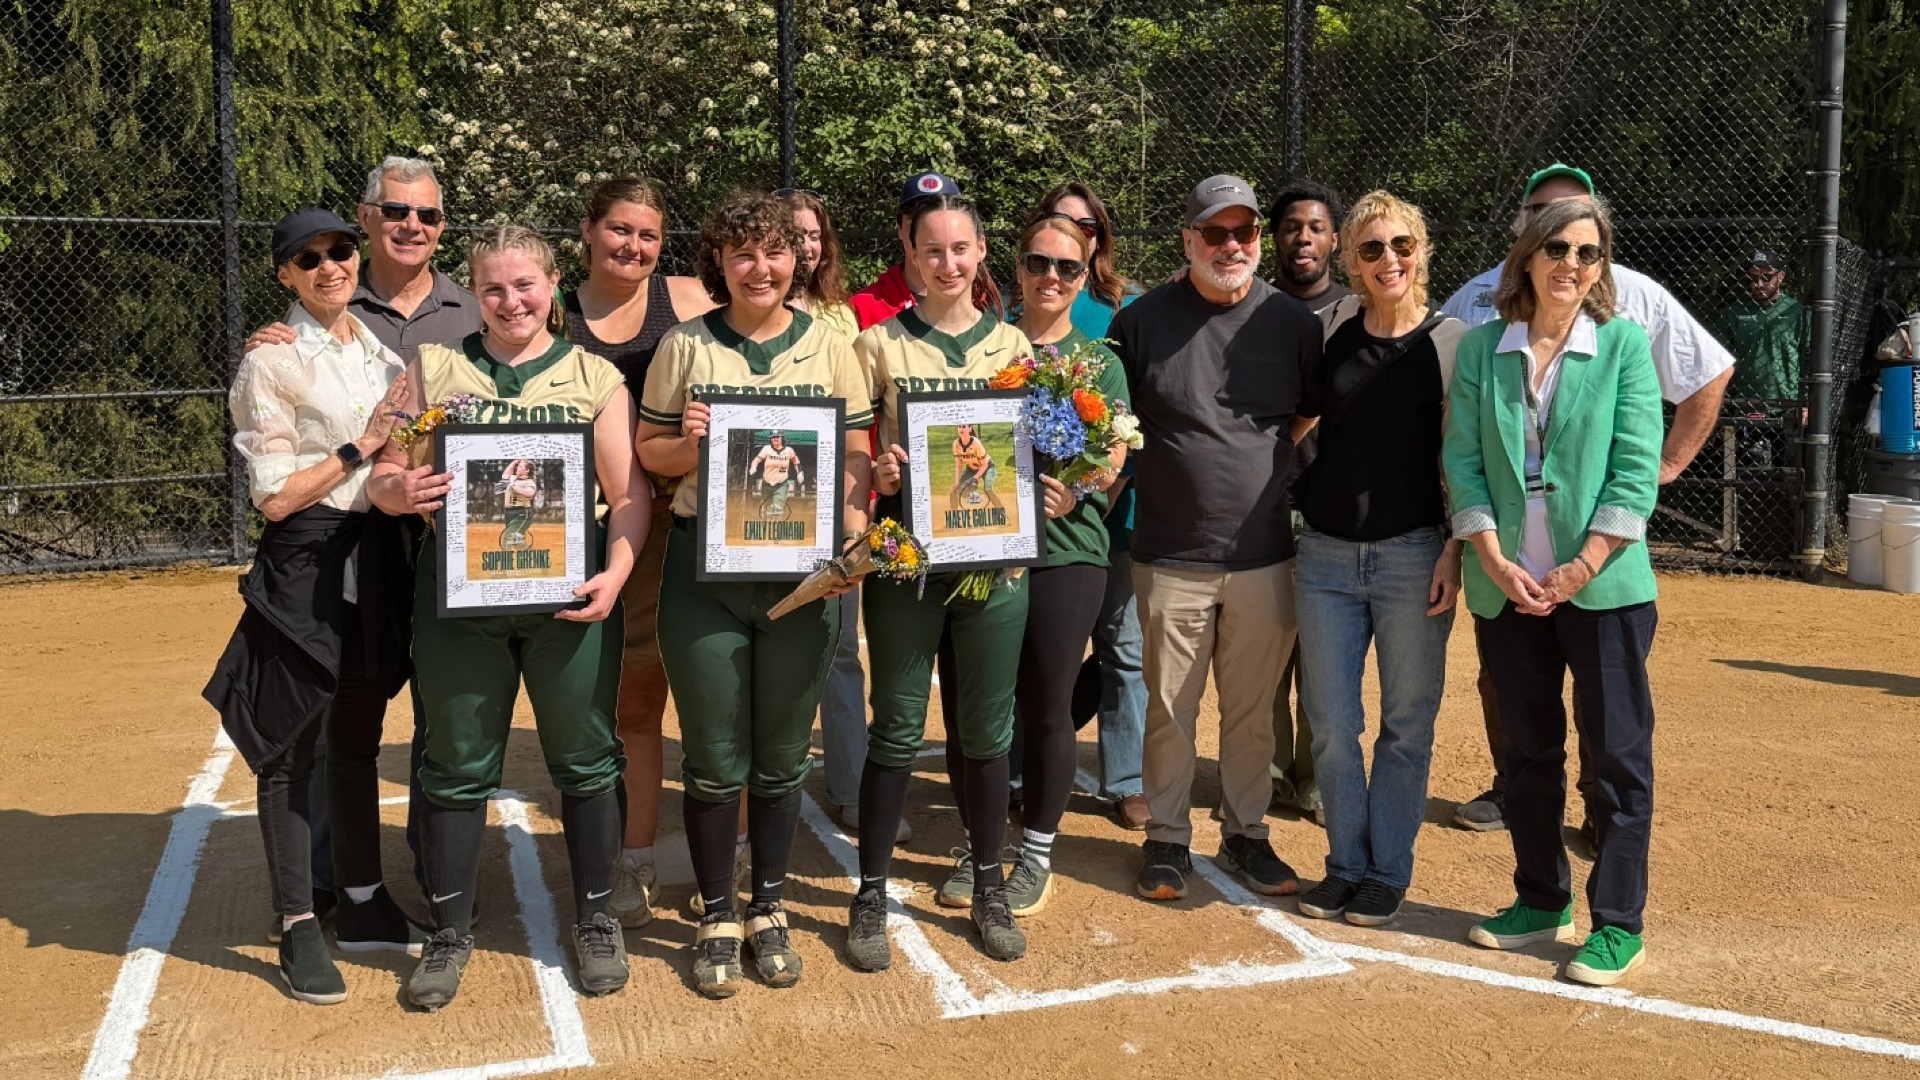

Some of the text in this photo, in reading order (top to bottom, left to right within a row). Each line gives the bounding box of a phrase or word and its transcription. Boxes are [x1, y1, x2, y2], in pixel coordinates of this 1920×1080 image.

[893, 376, 994, 394] GRYPHO
[474, 399, 582, 424] YPHONS
[743, 521, 805, 541] EMILY LEONARD
[482, 550, 515, 571] SOPHIE
